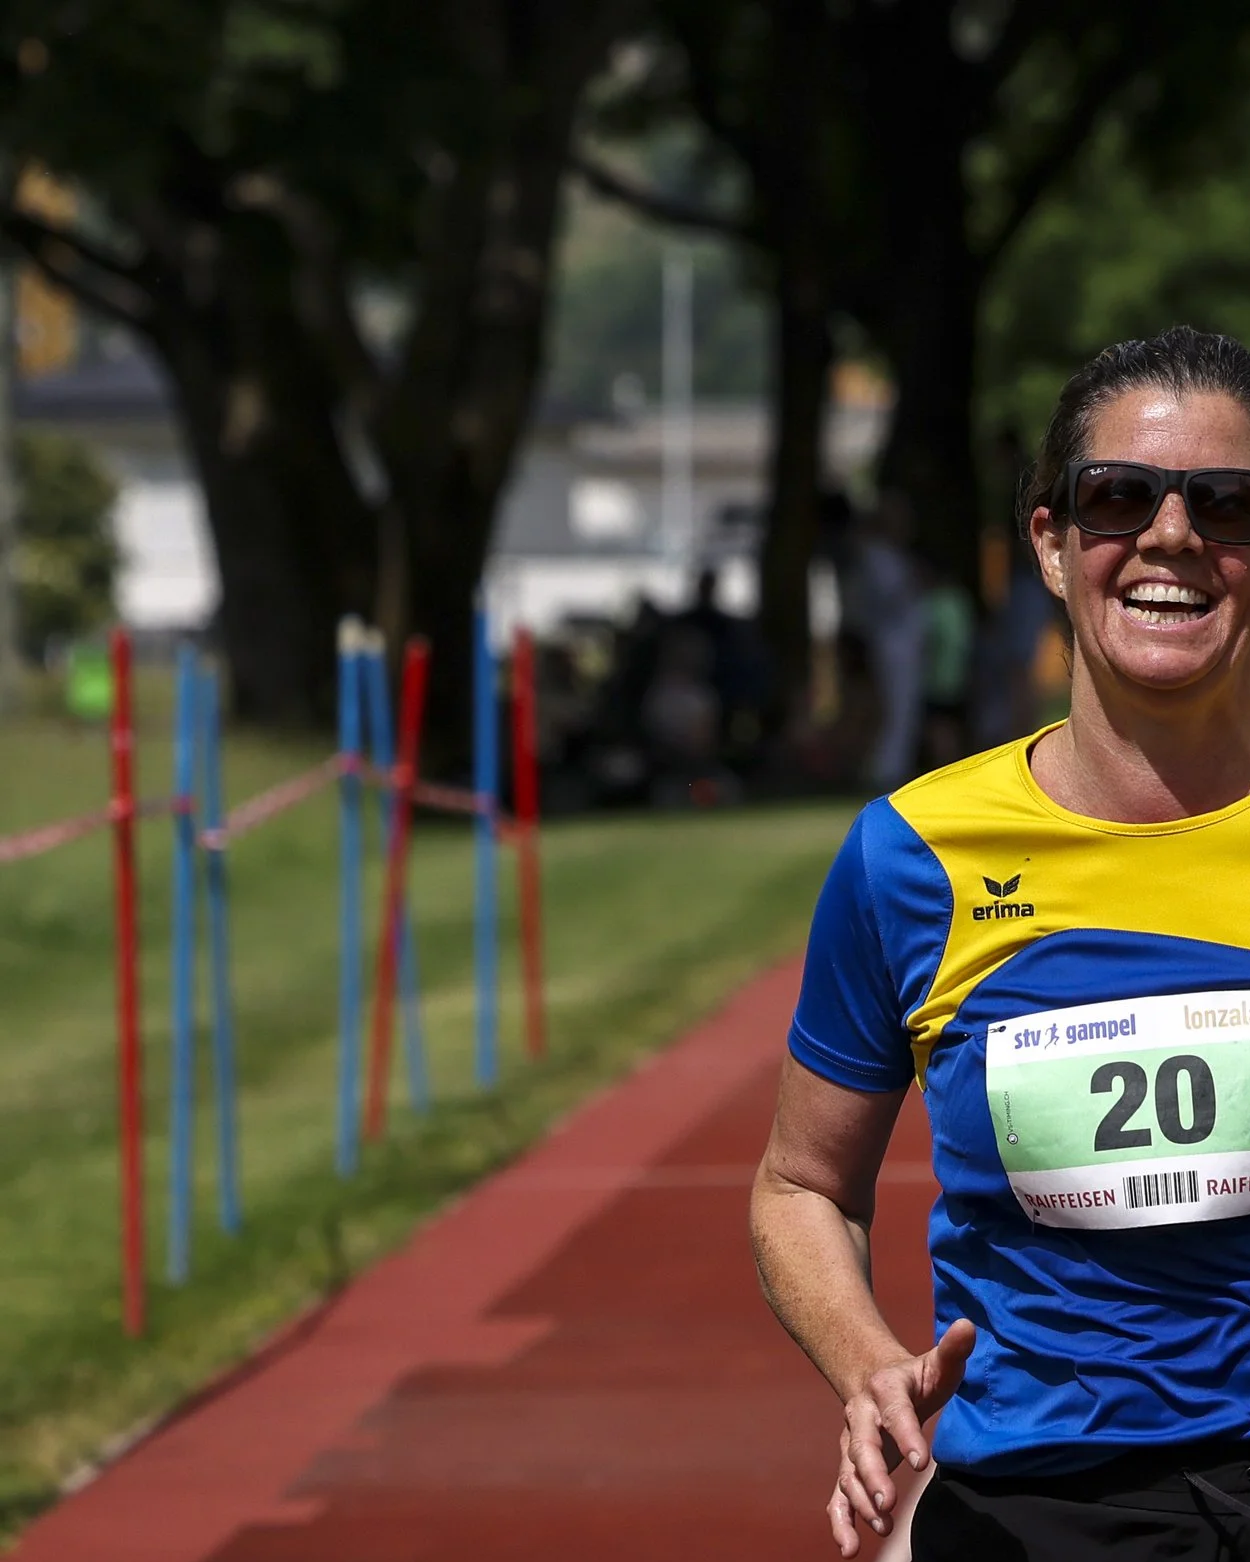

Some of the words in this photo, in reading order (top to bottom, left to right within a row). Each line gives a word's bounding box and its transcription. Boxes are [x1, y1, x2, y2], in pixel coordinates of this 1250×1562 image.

[972, 900, 1034, 920] erima
[1014, 1029, 1041, 1049] stv
[1066, 1013, 1136, 1044] gampel
[1090, 1055, 1216, 1152] 20
[1024, 1189, 1117, 1209] RAIFFEISEN
